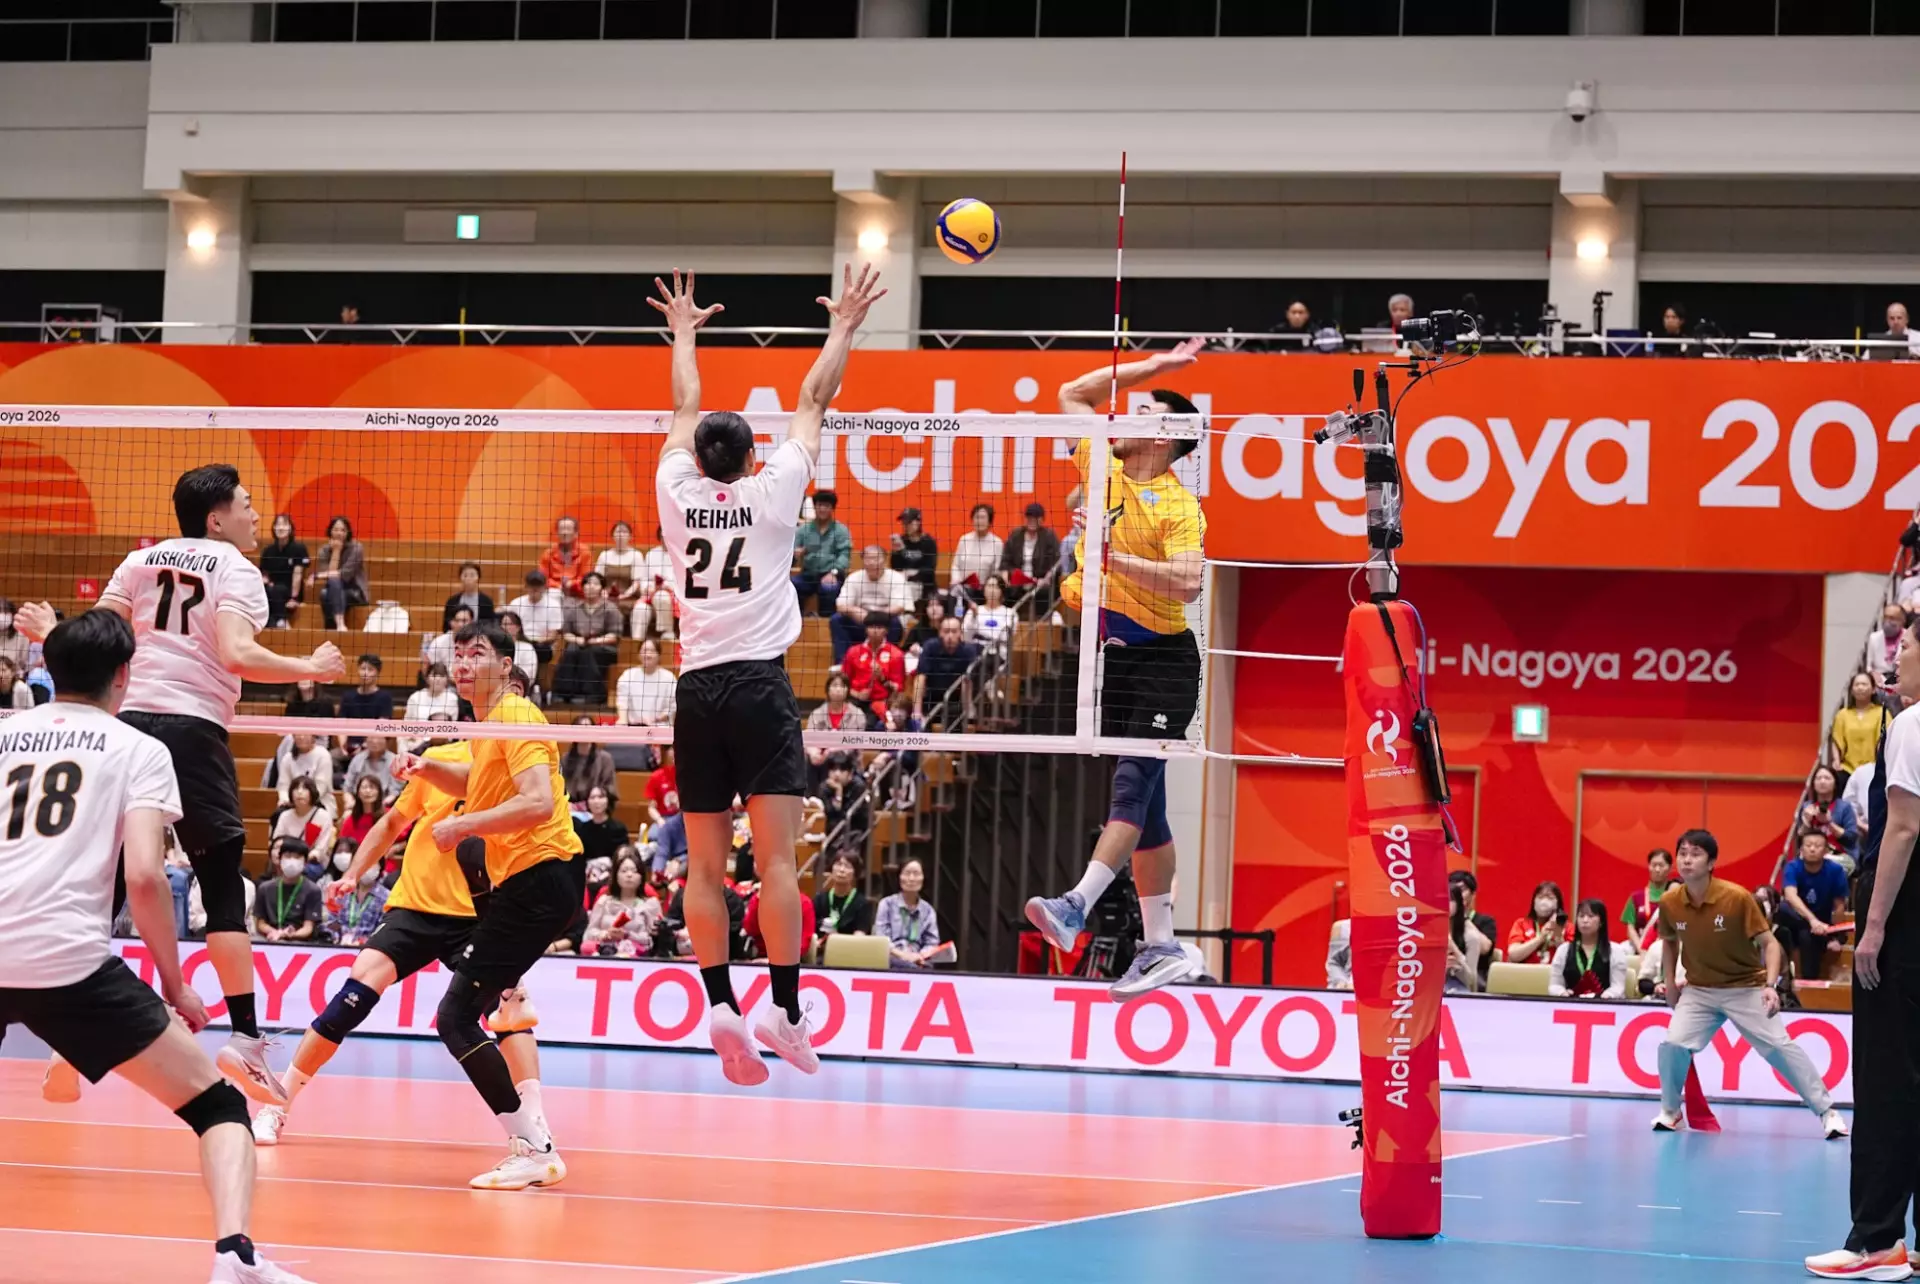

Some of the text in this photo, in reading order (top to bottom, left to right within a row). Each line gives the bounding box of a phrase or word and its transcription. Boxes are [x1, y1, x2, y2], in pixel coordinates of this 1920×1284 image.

[27, 410, 60, 422] 2026
[365, 412, 499, 429] Aichi-Nagoya 2026
[821, 417, 960, 434] Aichi-Nagoya 2026
[686, 507, 752, 529] KEIHAN
[145, 551, 218, 573] NISHIMOTO
[685, 536, 752, 599] 24
[155, 568, 205, 635] 17
[1632, 647, 1738, 683] 2026
[375, 724, 458, 734] Aichi-Nagoya 2026
[0, 730, 107, 754] NISHIYAMA
[841, 736, 929, 747] Aichi-Nagoya 2026
[6, 761, 83, 840] 18
[1383, 824, 1424, 1109] Aichi-Nagoya 2026
[1054, 987, 1471, 1079] TOYO
